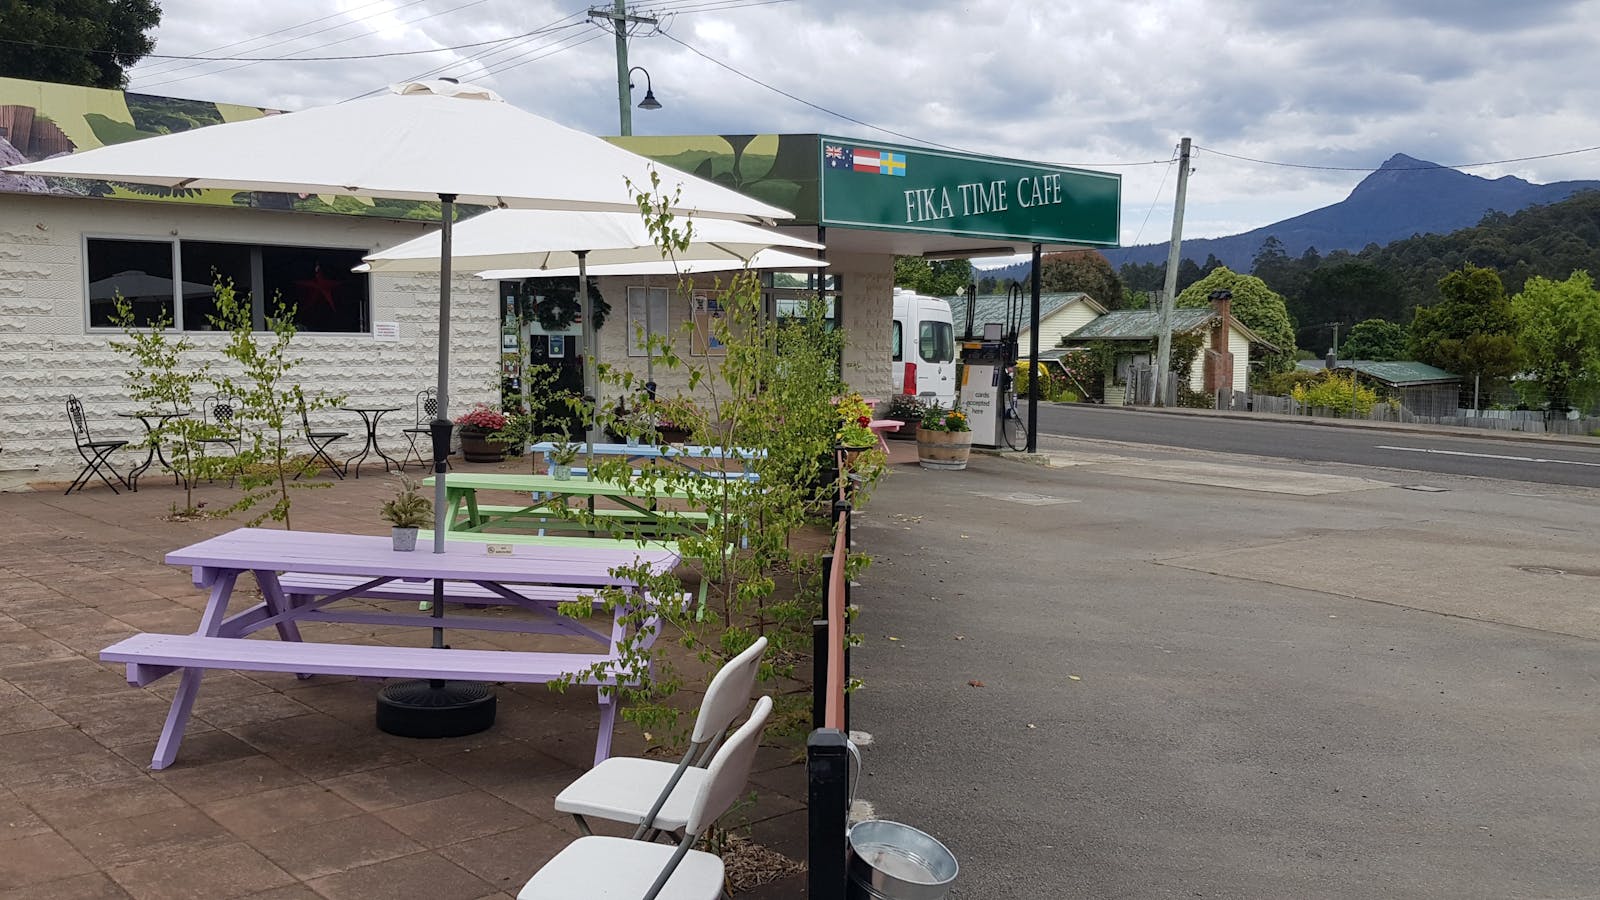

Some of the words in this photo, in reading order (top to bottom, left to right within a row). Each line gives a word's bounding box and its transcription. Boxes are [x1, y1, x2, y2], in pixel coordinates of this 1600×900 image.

[903, 186, 954, 223] FIKA
[958, 180, 1008, 217] TIME
[1017, 174, 1062, 208] CAFE
